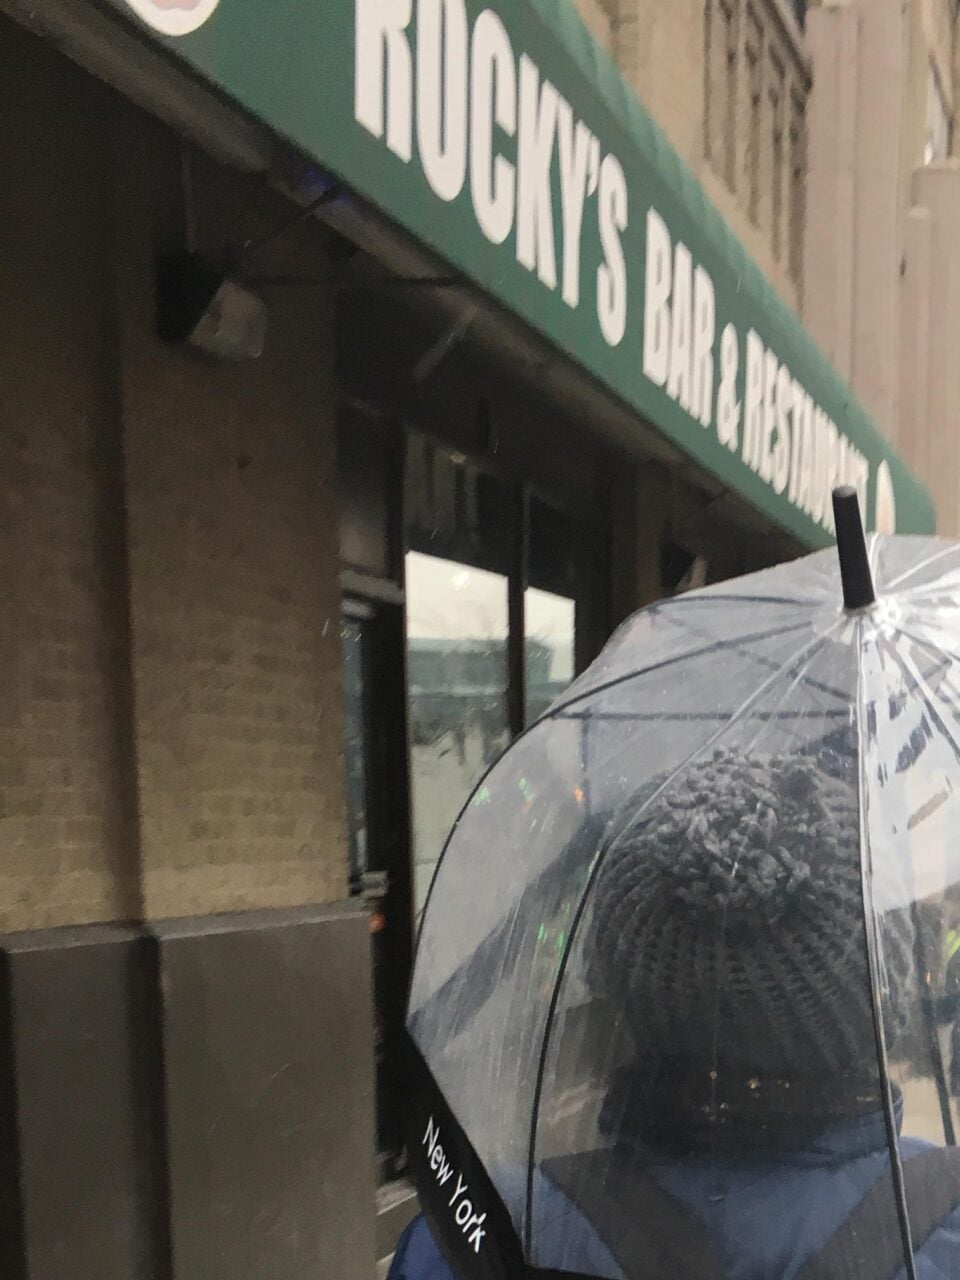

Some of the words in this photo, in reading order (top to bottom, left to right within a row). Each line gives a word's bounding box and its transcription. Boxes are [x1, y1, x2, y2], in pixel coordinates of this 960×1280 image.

[353, 0, 629, 347] ROCKY'S
[643, 205, 716, 429] BAR
[716, 321, 742, 454] &
[422, 1115, 454, 1186] New
[448, 1172, 488, 1254] York
